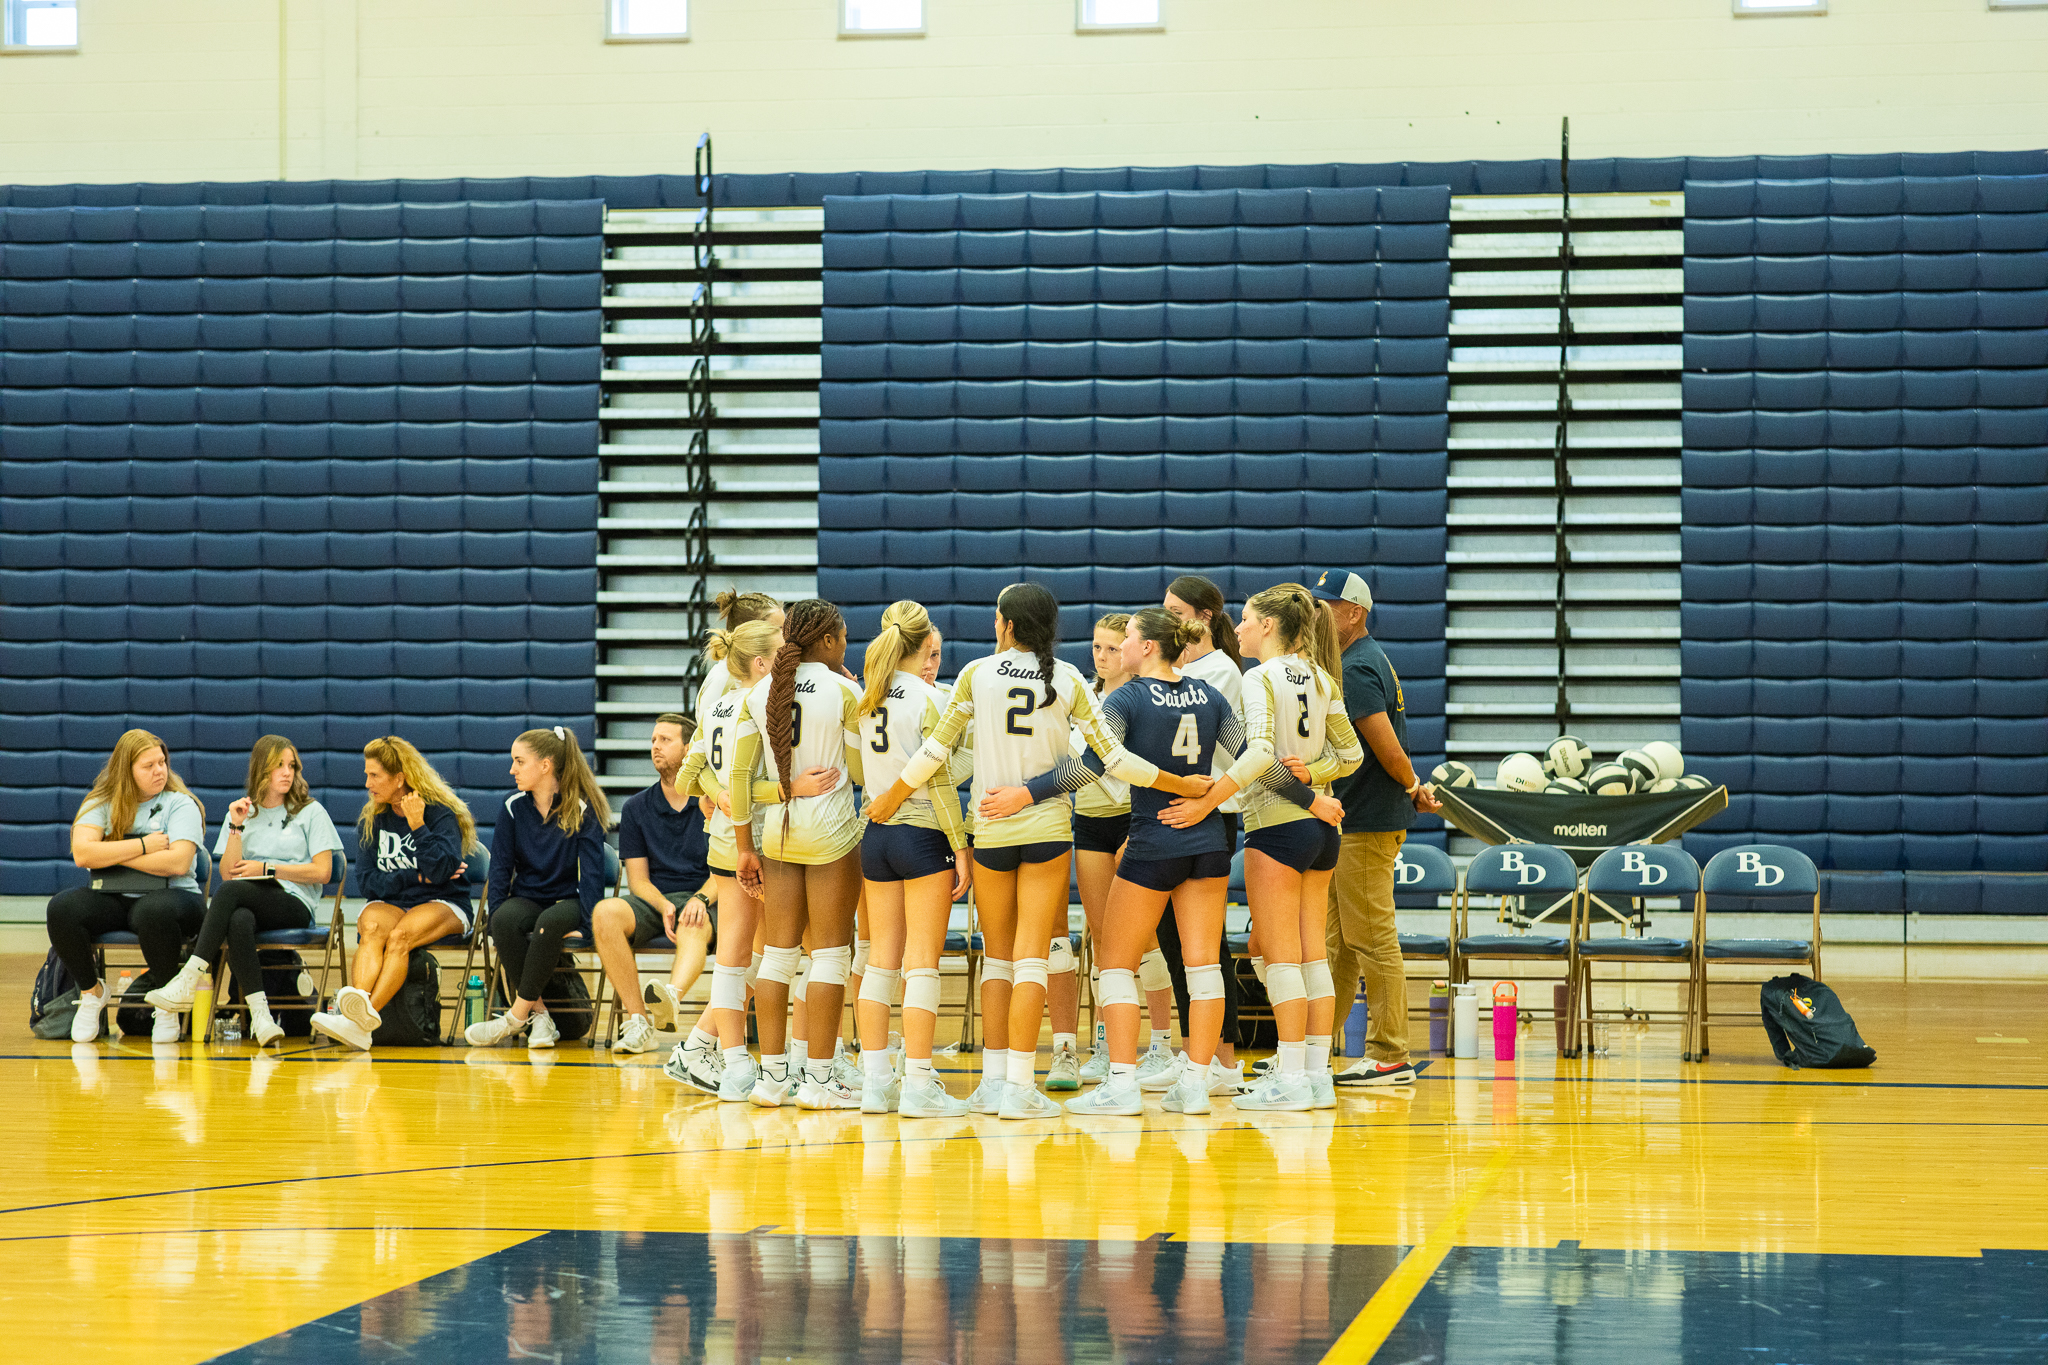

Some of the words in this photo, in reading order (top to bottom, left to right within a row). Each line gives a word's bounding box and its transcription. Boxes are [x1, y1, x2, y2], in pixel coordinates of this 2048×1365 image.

[1005, 686, 1036, 737] 2
[1149, 684, 1208, 708] Saints
[870, 705, 890, 754] 3
[1172, 713, 1201, 765] 4
[711, 726, 723, 771] 6
[1554, 823, 1607, 837] molten
[1500, 851, 1547, 885] BD
[1621, 851, 1668, 886] BD
[1736, 852, 1785, 886] BD
